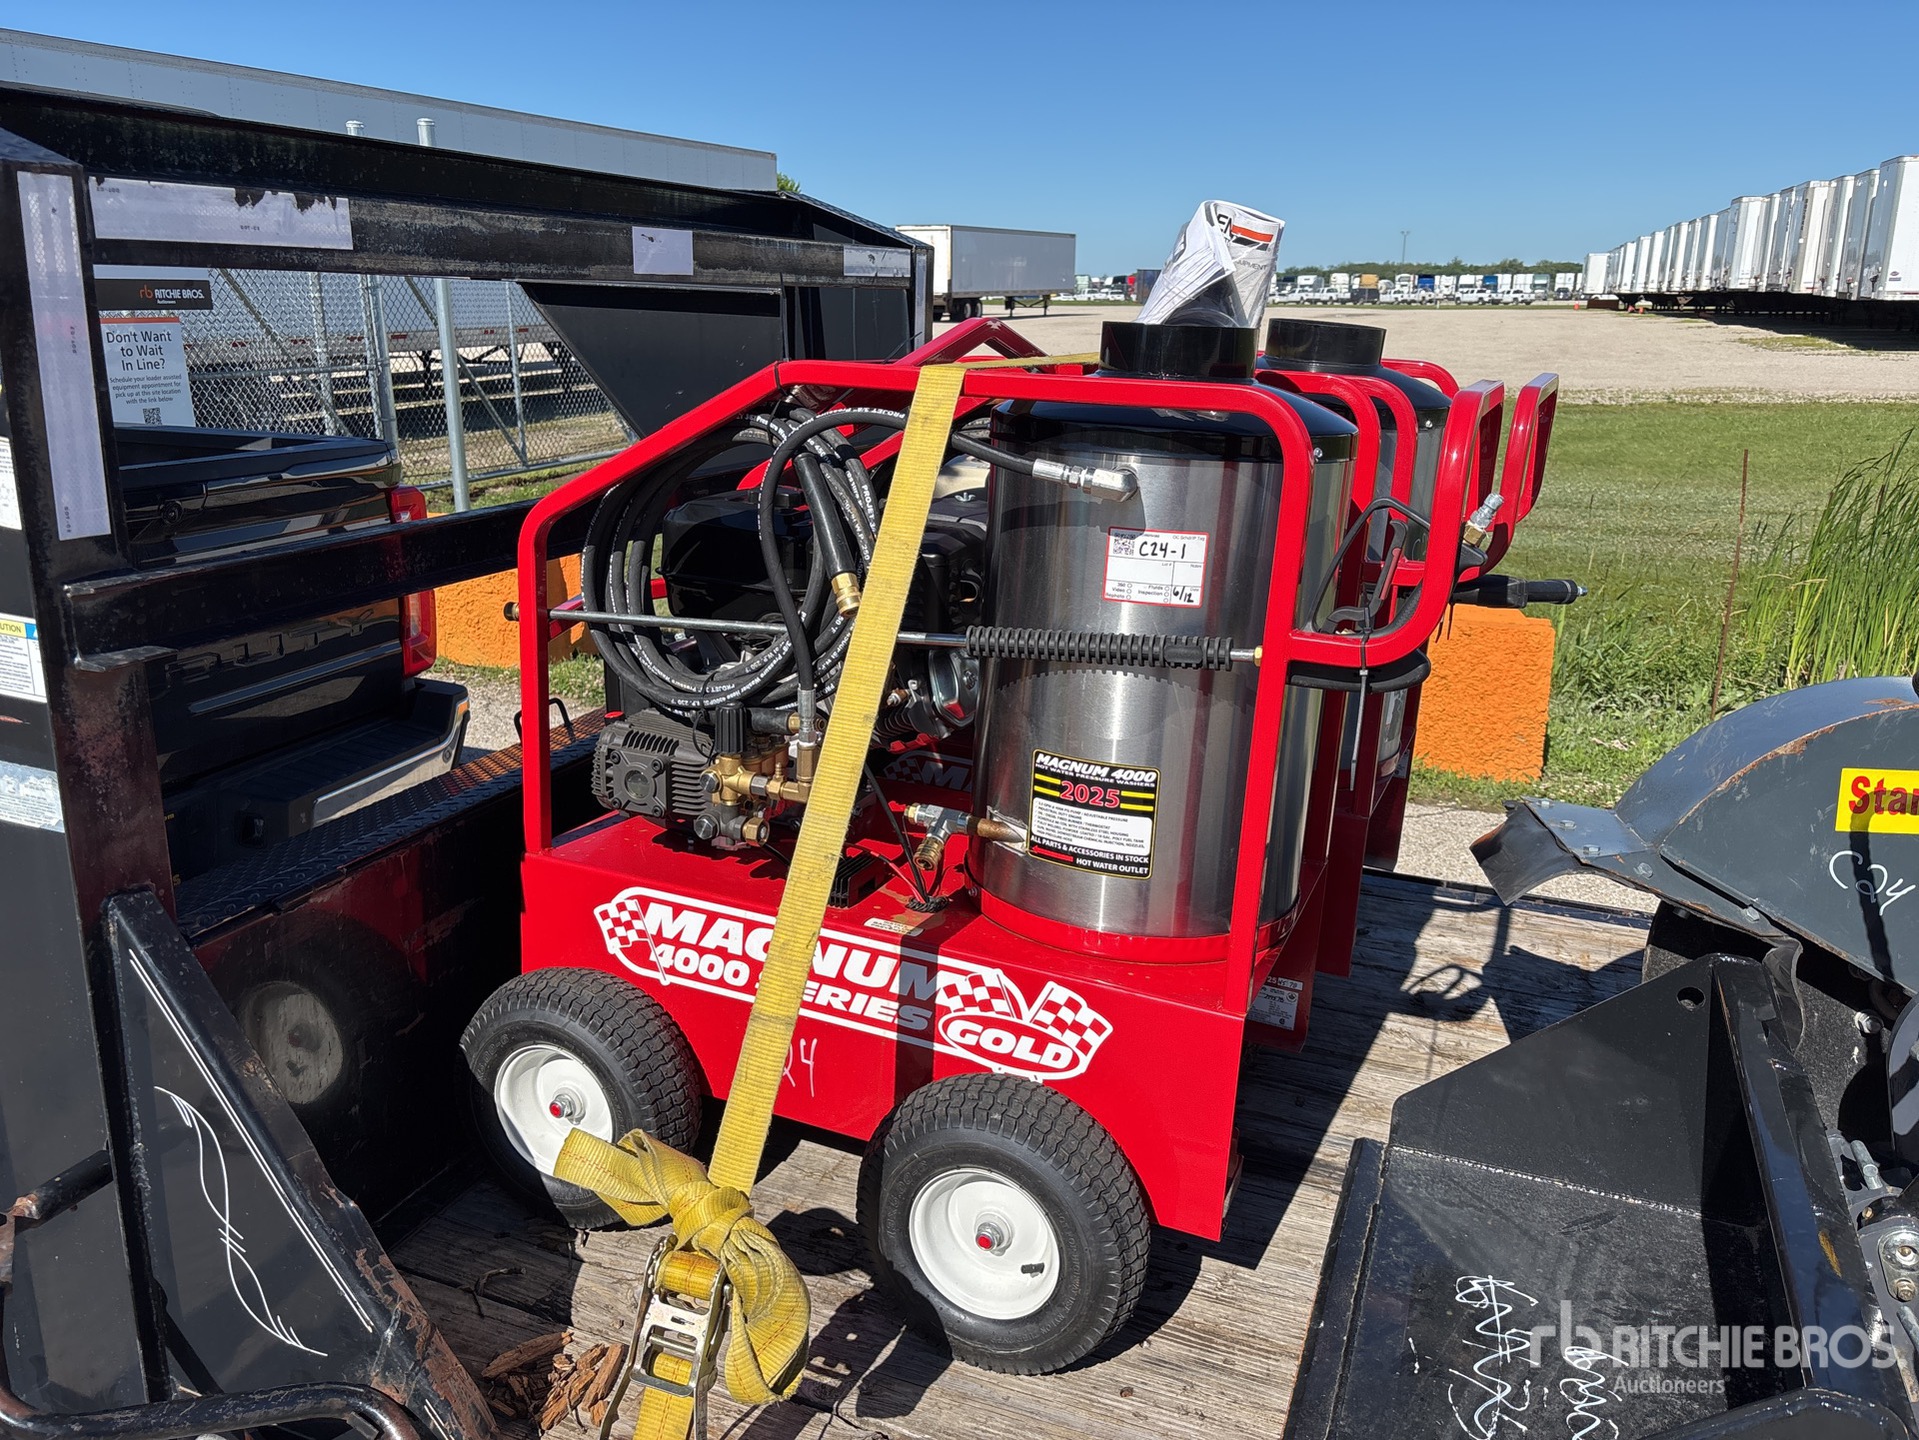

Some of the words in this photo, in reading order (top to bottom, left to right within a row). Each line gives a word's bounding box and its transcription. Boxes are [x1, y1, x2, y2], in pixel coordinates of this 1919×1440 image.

[154, 288, 181, 299] RITCHIE
[181, 289, 205, 299] BROS.
[106, 331, 138, 343] Don't
[140, 331, 172, 342] Want
[121, 346, 133, 357] to
[137, 344, 163, 356] Wait
[121, 360, 133, 371] In
[137, 359, 166, 371] Line?
[112, 383, 140, 391] equipment
[861, 484, 875, 520] PROJET
[1139, 540, 1186, 560] C24-1
[0, 623, 21, 633] UTION
[760, 653, 783, 678] Pressure
[741, 677, 761, 693] Washer
[726, 690, 742, 700] Hose
[1035, 763, 1049, 771] HOT
[1049, 766, 1074, 777] WATER
[1075, 770, 1115, 784] PRESSURE
[1115, 779, 1156, 788] WASHERS
[1036, 753, 1110, 778] MAGNUM
[1110, 768, 1157, 783] 4000
[1060, 780, 1120, 809] 2025
[1030, 835, 1042, 844] ALL
[1042, 838, 1062, 850] PARTS
[1068, 846, 1115, 860] ACCESSORIES
[1124, 855, 1150, 865] STOCK
[1076, 857, 1092, 867] HOT
[1092, 860, 1118, 871] WATER
[1118, 864, 1149, 874] OUTLET
[649, 942, 750, 987] 4000
[755, 974, 933, 1031] ERIES
[947, 1018, 1075, 1069] GOLD
